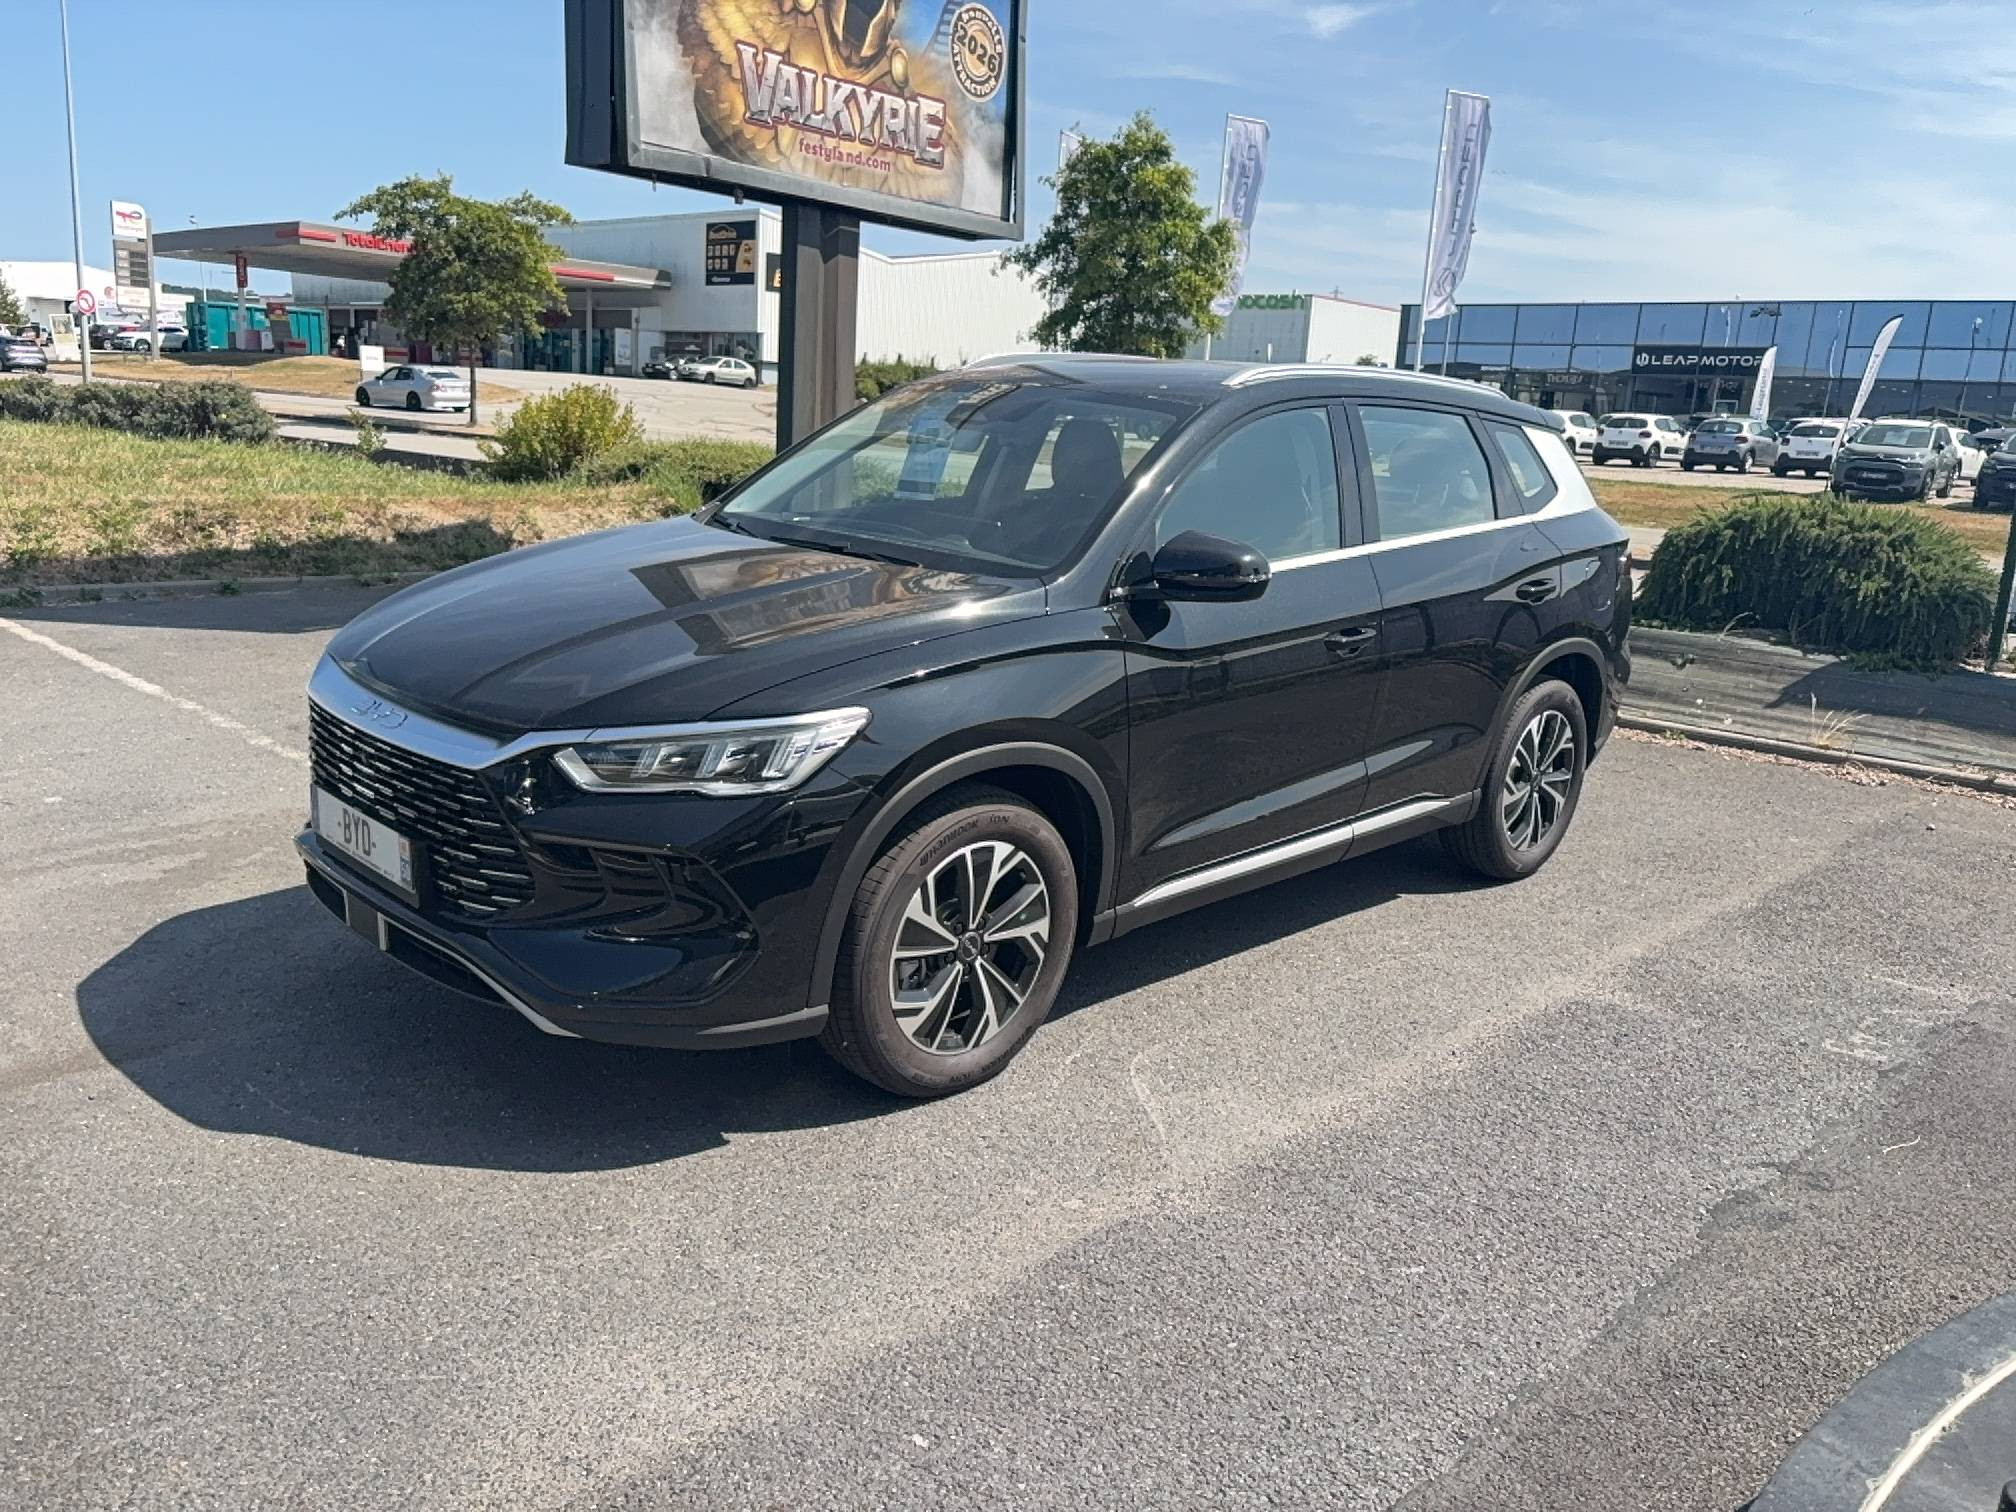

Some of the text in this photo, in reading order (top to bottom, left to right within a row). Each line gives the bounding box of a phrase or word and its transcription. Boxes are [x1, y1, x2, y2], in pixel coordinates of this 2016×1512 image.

[952, 43, 997, 95] ATTRACTION
[956, 23, 998, 72] 2026
[737, 42, 945, 168] VALKYRIE
[799, 138, 891, 172] festyland.com
